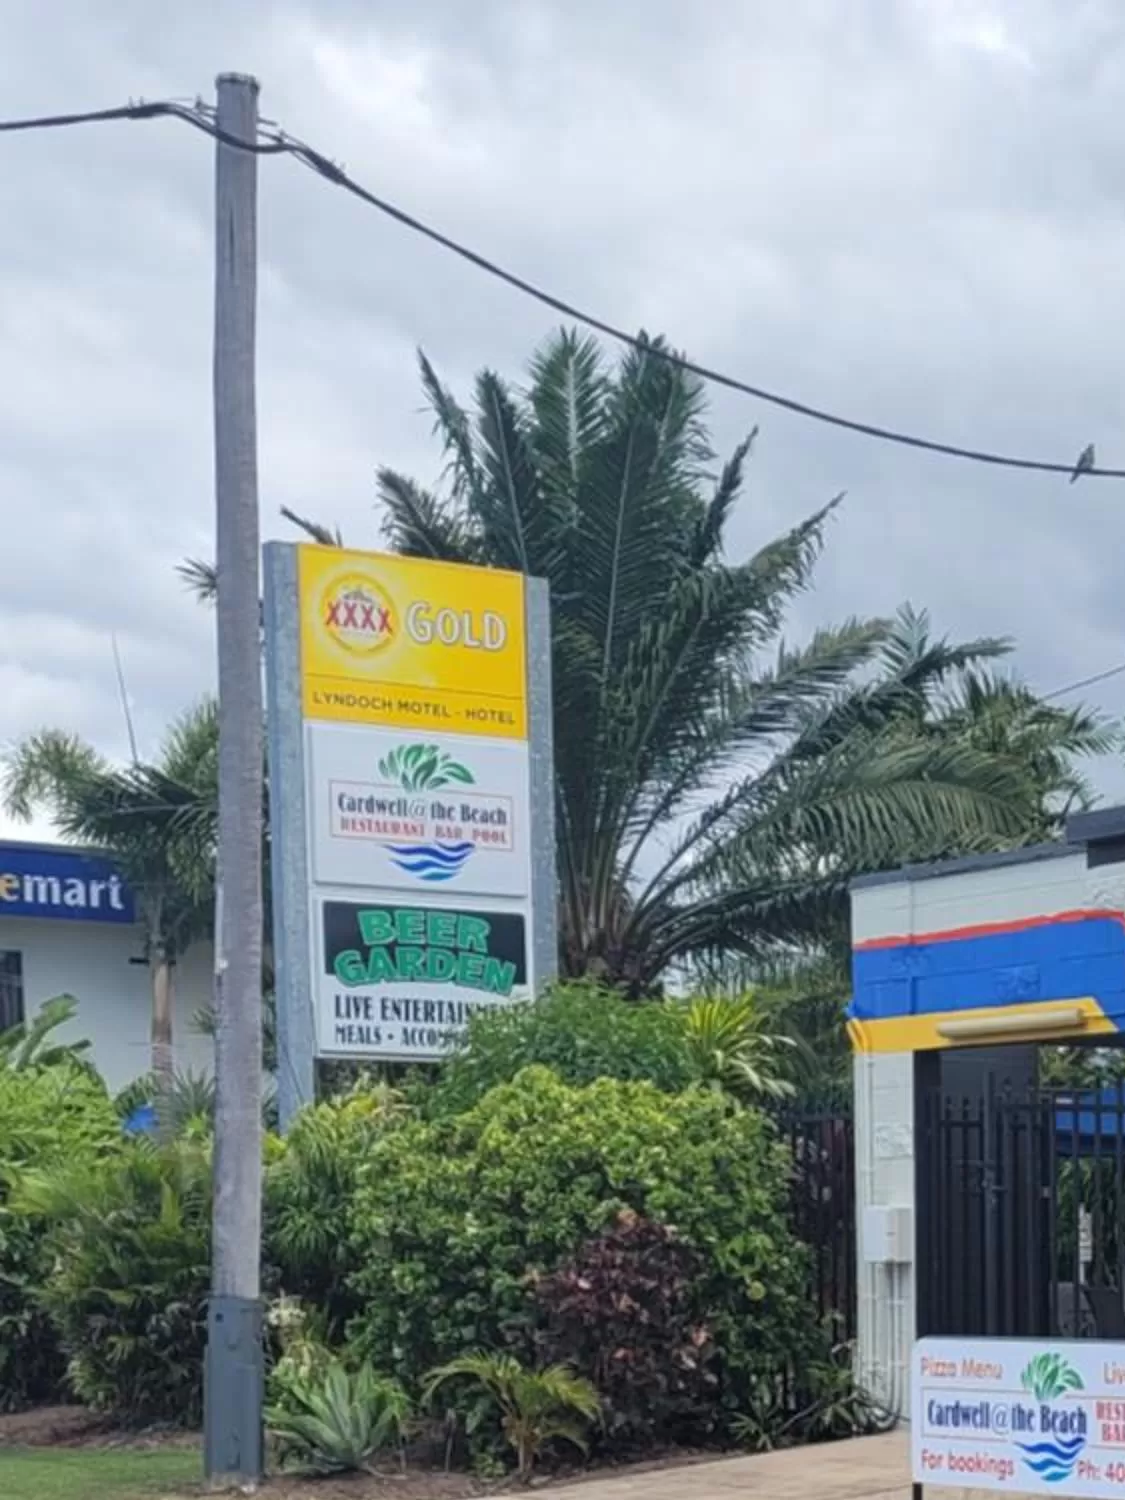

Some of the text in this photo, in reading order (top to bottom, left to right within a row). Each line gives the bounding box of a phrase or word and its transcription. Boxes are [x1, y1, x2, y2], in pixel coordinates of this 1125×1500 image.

[325, 600, 507, 650] XXXX GOLD
[313, 691, 392, 711] LYNDOCH
[465, 707, 516, 725] HOTEL
[461, 803, 507, 826] Beach
[341, 818, 507, 844] RESTAURANT BAR POOL
[357, 910, 490, 953] BEER
[334, 947, 516, 996] GARDEN
[335, 994, 373, 1021] LIVE
[335, 1024, 381, 1045] MEALS
[921, 1357, 1002, 1379] Pizza Menu
[1040, 1404, 1087, 1435] Beach
[922, 1448, 1013, 1480] For bookings
